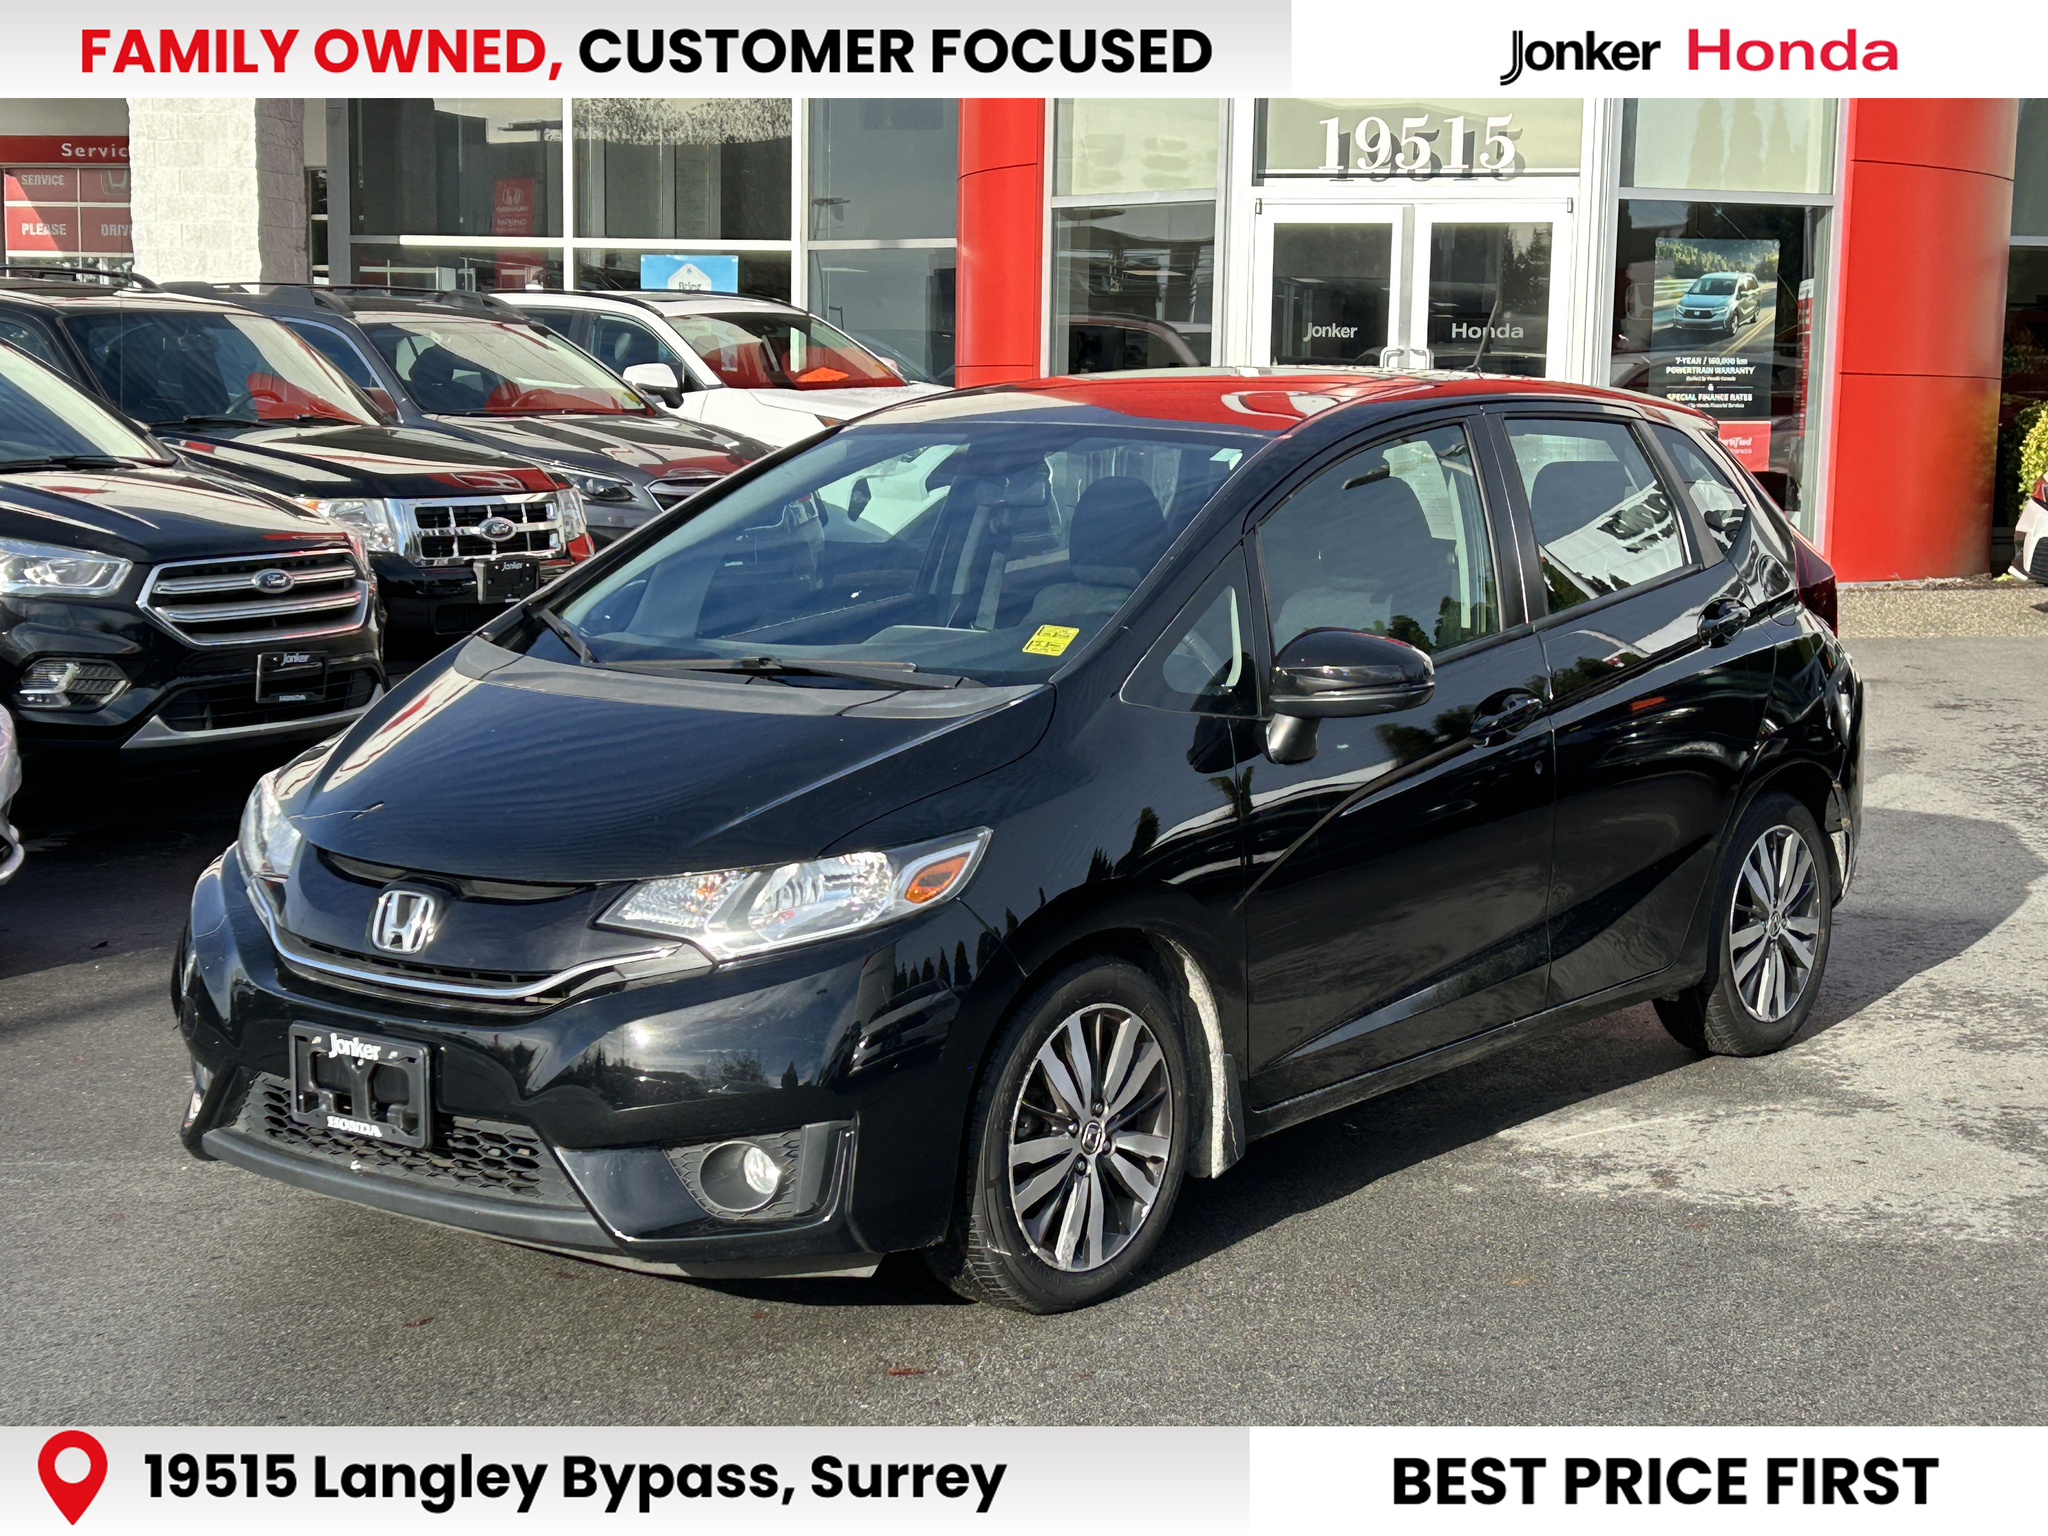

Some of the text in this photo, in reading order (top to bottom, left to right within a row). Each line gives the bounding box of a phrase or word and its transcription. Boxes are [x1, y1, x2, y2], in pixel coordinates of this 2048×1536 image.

[61, 142, 129, 158] Servic
[1318, 113, 1516, 171] 19515
[21, 174, 66, 186] SERVICE
[21, 223, 133, 236] PLEASE DRIV
[1303, 321, 1358, 342] Jonker
[1451, 322, 1524, 339] Honda
[328, 1032, 381, 1061] Jonker
